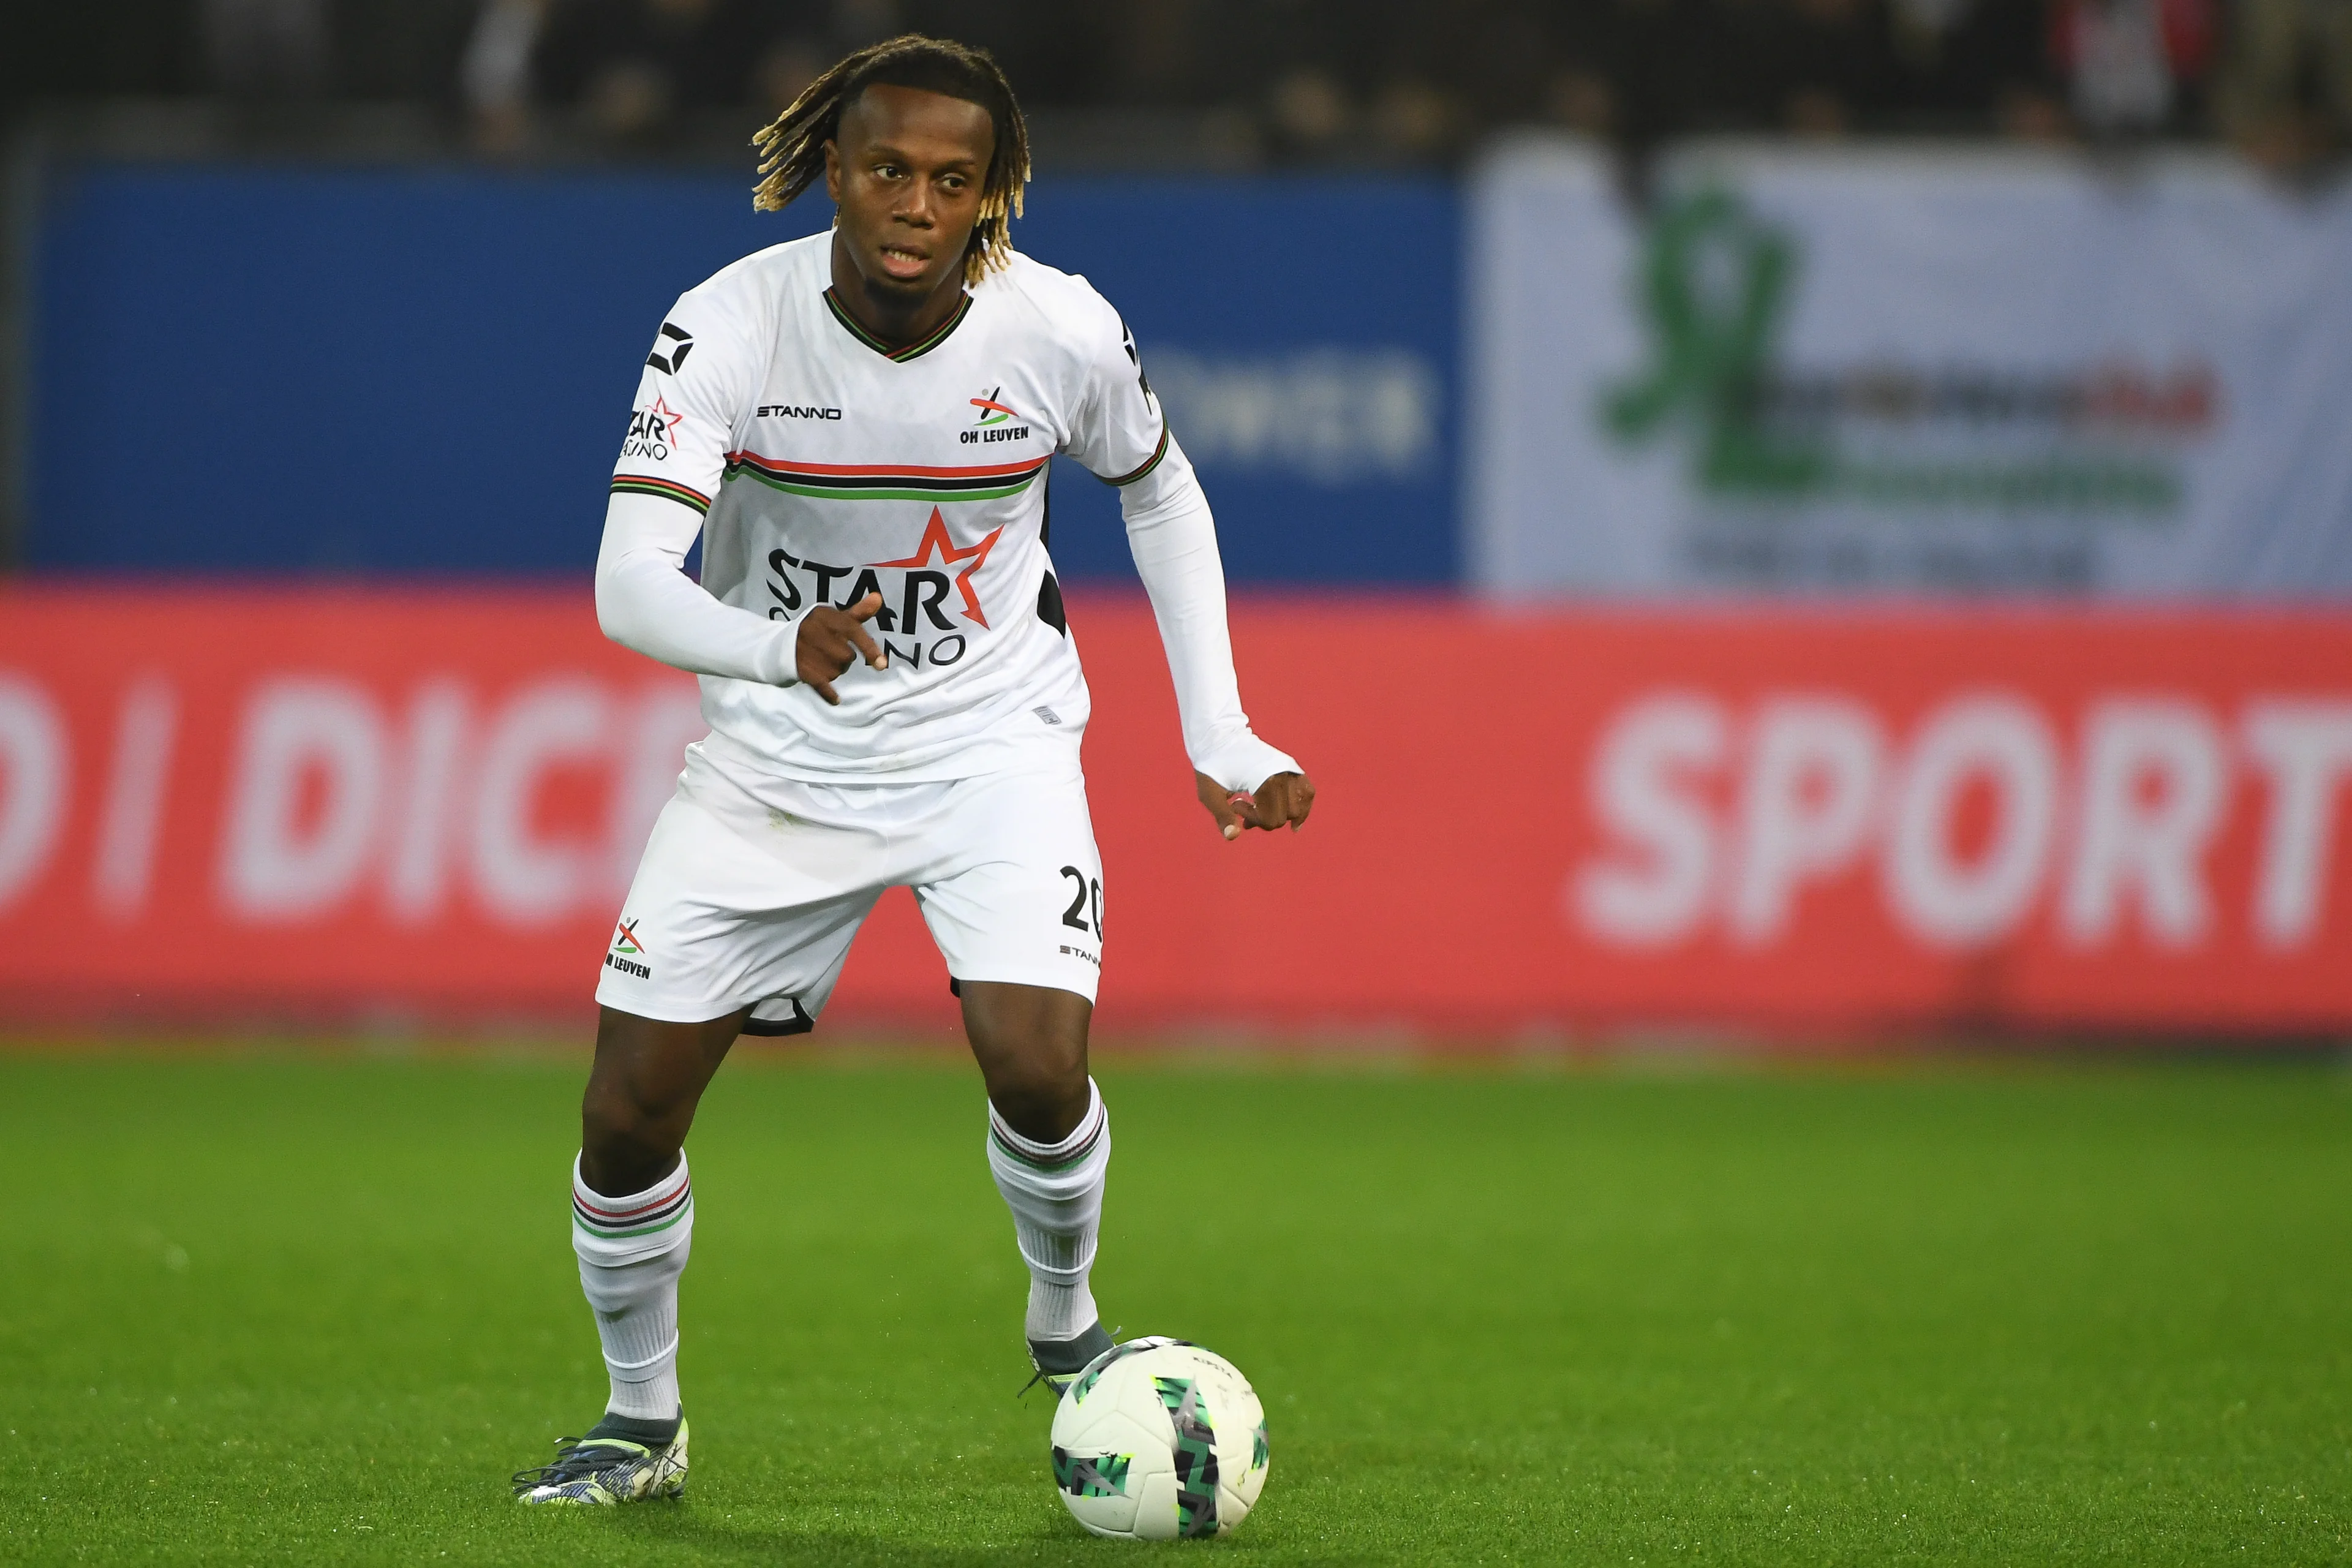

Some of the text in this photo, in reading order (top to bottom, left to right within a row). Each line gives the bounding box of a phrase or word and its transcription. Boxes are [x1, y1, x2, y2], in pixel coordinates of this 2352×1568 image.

[756, 405, 842, 420] STANNO
[960, 426, 1029, 444] OH LEUVEN
[766, 548, 959, 635] STAR
[1569, 687, 2352, 946] SPORT
[614, 956, 651, 980] LEUVEN
